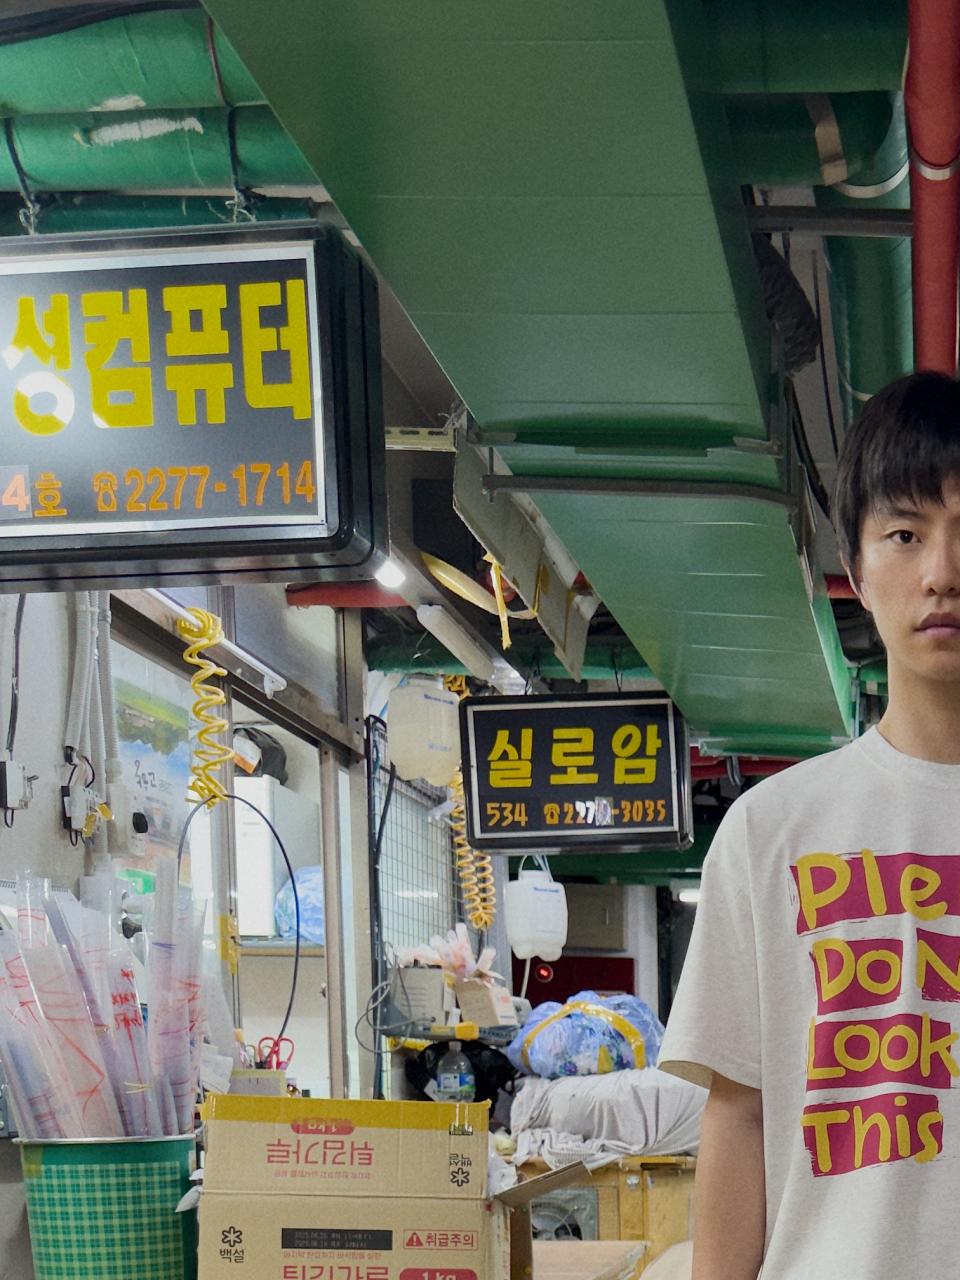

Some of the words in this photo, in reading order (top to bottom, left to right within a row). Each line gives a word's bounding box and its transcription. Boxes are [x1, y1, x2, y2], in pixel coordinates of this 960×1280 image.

[3, 279, 312, 435] 성컴퓨터
[125, 460, 316, 512] 2277-1714
[487, 724, 662, 788] 실로암
[487, 802, 528, 827] 534
[266, 1137, 374, 1166] 튀김가루
[802, 1095, 943, 1173] This
[219, 1248, 245, 1264] 백설
[426, 1232, 474, 1248] 취급주의
